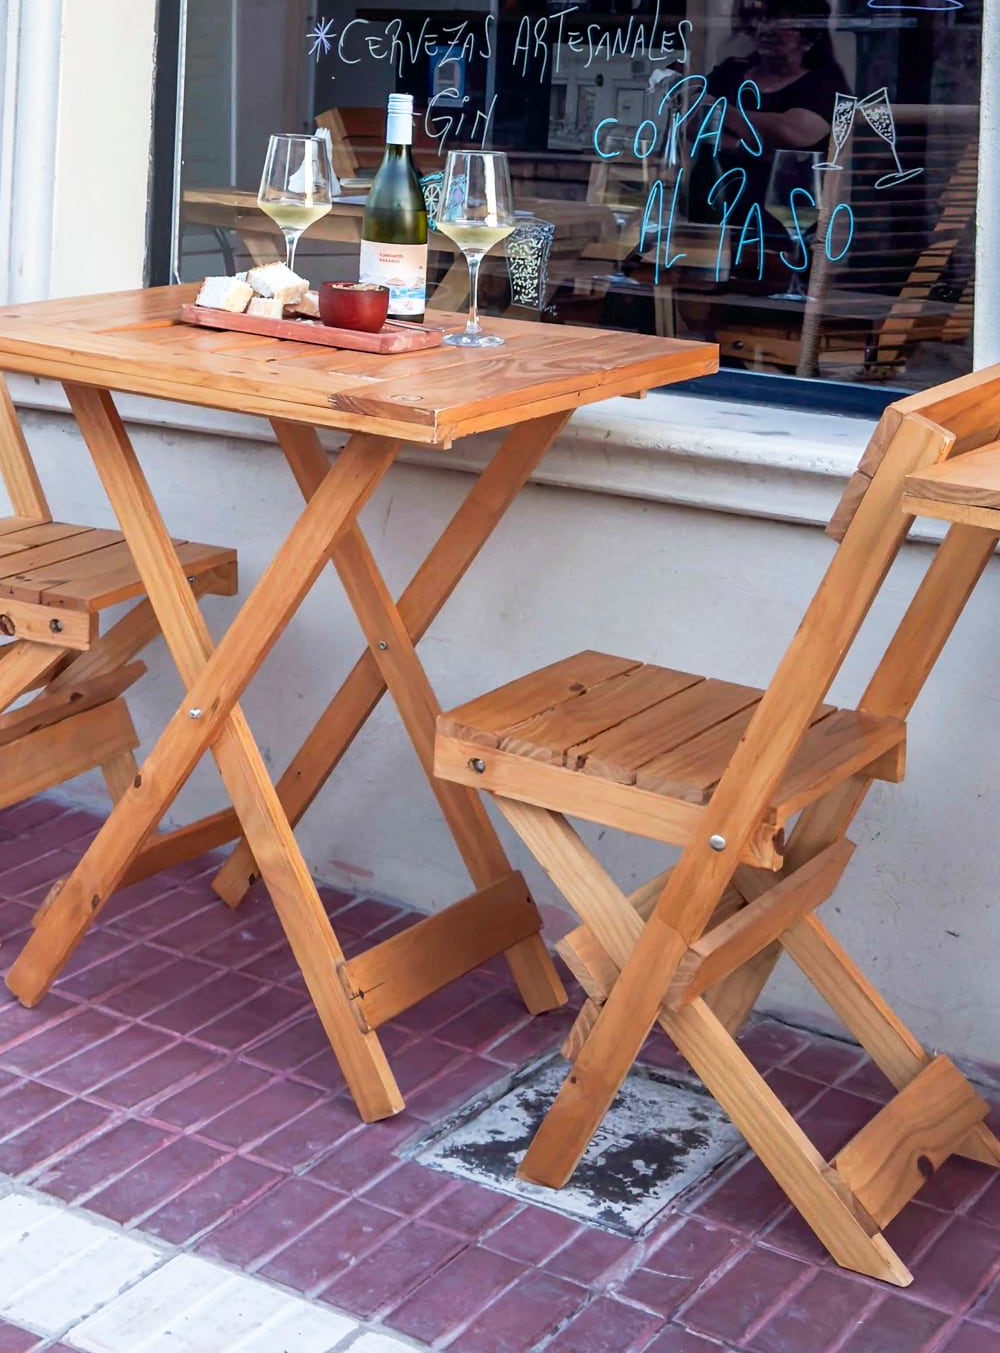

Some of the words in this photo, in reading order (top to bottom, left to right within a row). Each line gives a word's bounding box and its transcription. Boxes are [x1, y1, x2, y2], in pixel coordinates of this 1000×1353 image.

[337, 13, 496, 78] CERVEZAS
[593, 74, 763, 168] COPAS
[638, 167, 689, 285] AL
[707, 166, 855, 284] PASO
